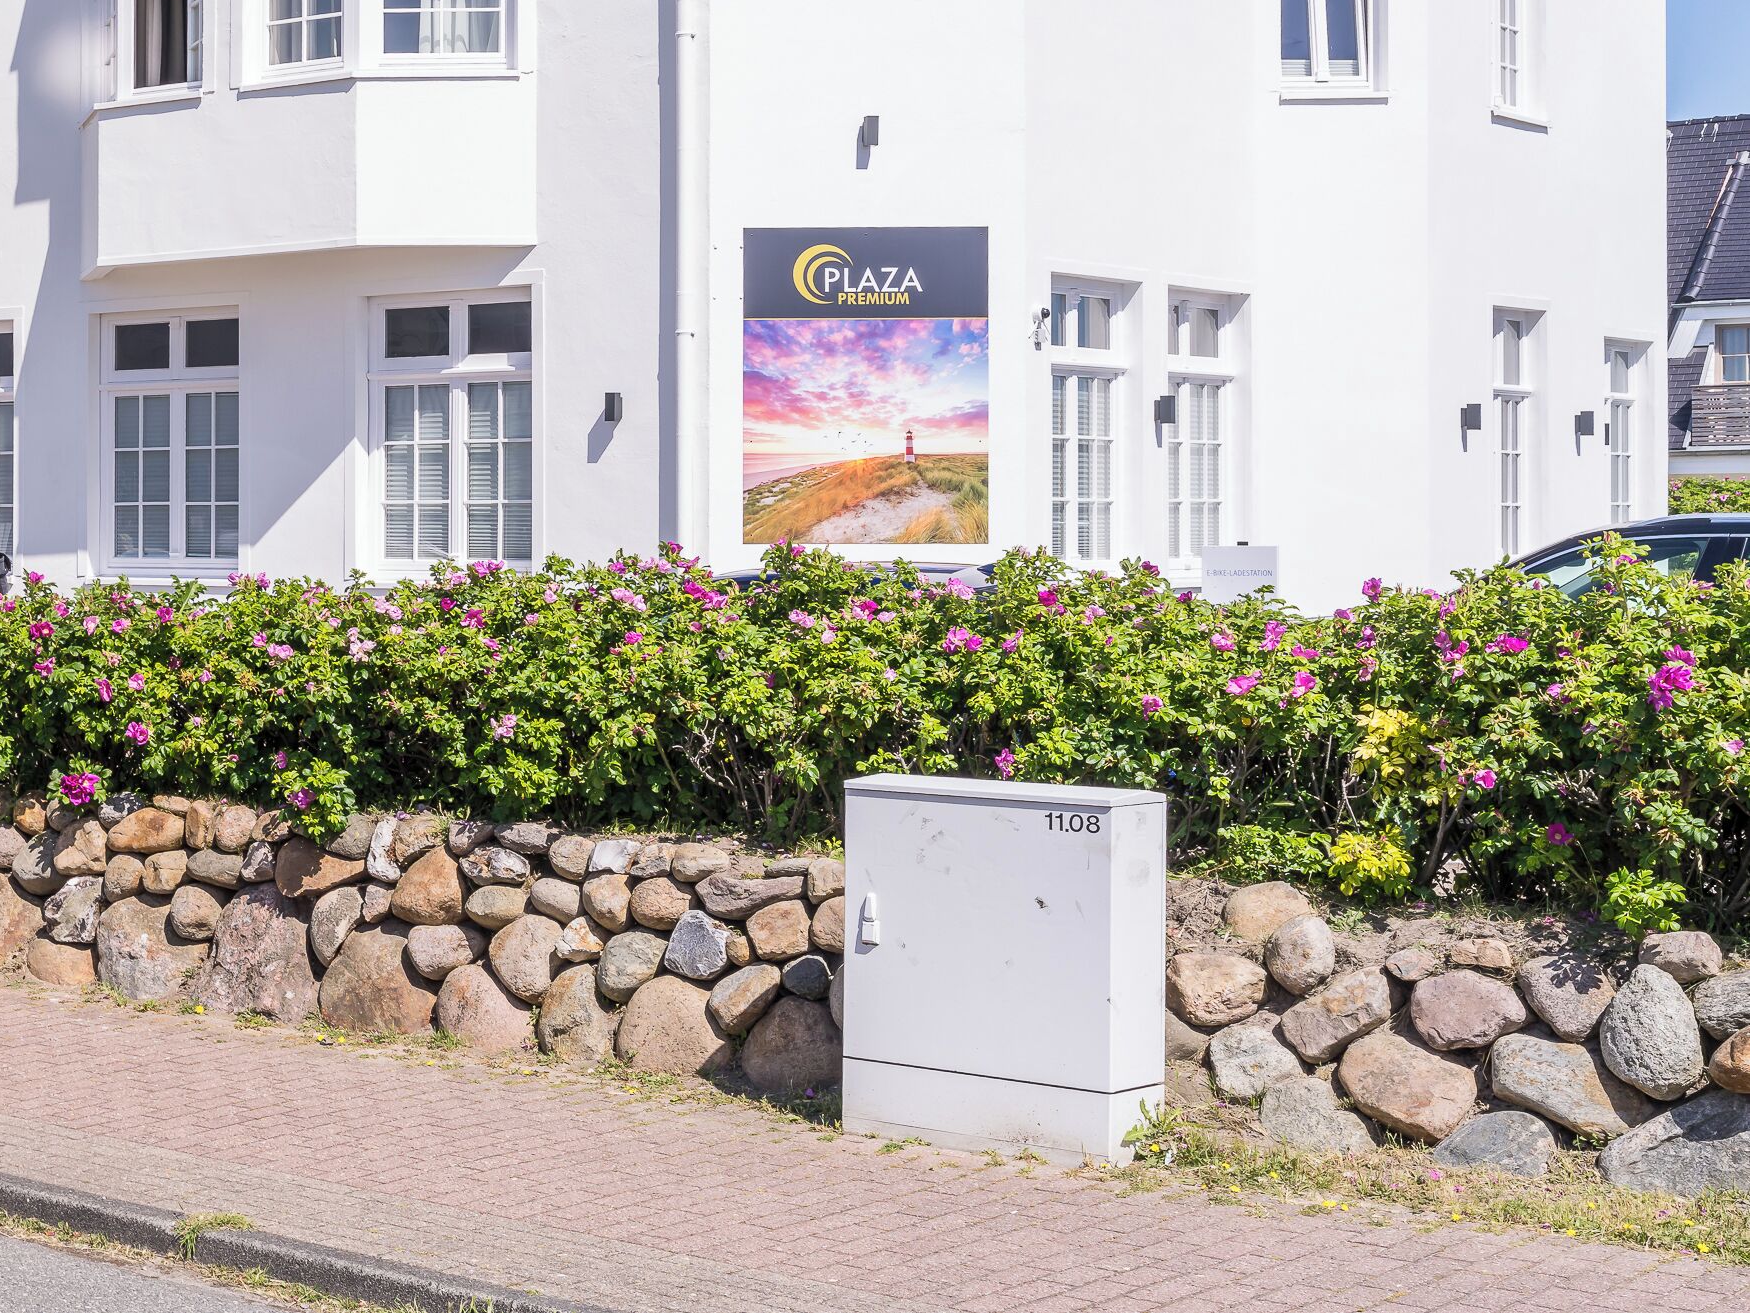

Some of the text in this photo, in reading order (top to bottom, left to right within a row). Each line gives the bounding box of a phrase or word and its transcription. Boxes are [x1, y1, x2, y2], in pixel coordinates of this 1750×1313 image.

[824, 266, 923, 292] PLAZA
[838, 292, 910, 305] PREMIUM
[1206, 569, 1273, 577] E-BIKE-LADESTATION
[1044, 812, 1101, 834] 11.08
